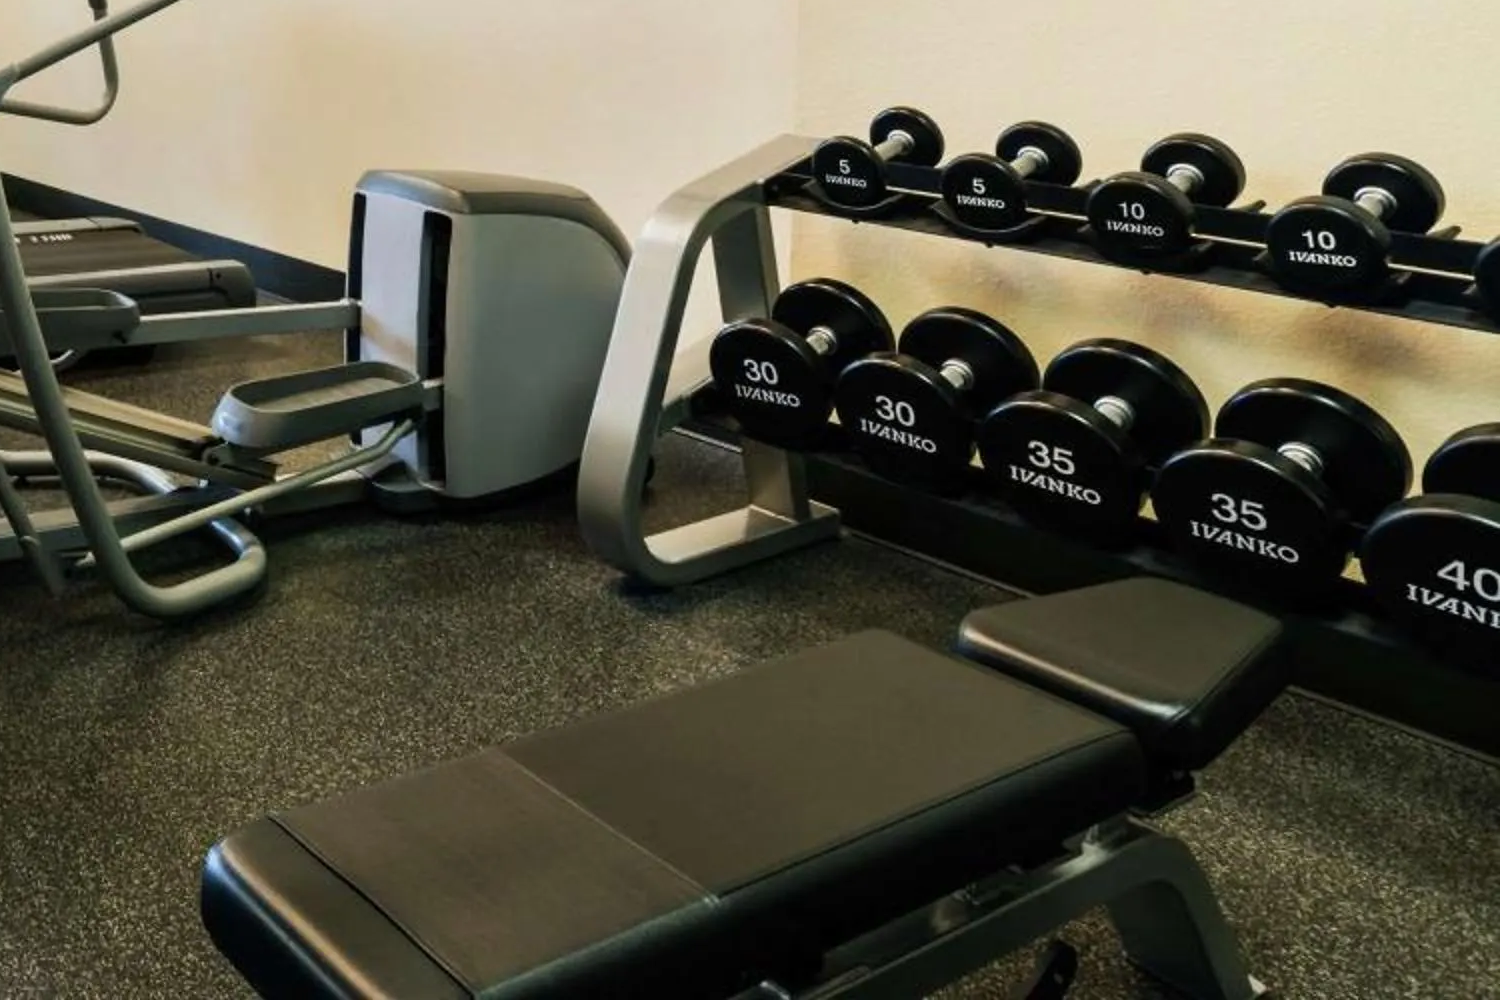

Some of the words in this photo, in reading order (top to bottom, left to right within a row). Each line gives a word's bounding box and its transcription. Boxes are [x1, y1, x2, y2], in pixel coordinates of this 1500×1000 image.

[839, 159, 851, 175] 5
[825, 173, 868, 189] IVANKO
[972, 178, 986, 195] 5
[956, 194, 1006, 210] IVANKO
[1119, 202, 1146, 220] 10
[1106, 221, 1165, 238] IVANKO
[1301, 230, 1337, 251] 10
[1288, 250, 1358, 268] IVANKO
[743, 359, 779, 385] 30
[735, 384, 801, 408] IVANKO
[875, 395, 916, 427] 30
[860, 418, 938, 453] IVANKO
[1028, 440, 1076, 475] 35
[1010, 465, 1102, 505] IVANKO
[1211, 492, 1268, 531] 35
[1190, 520, 1300, 563] IVANKO
[1436, 560, 1500, 602] 40
[1406, 583, 1500, 629] IVAN
